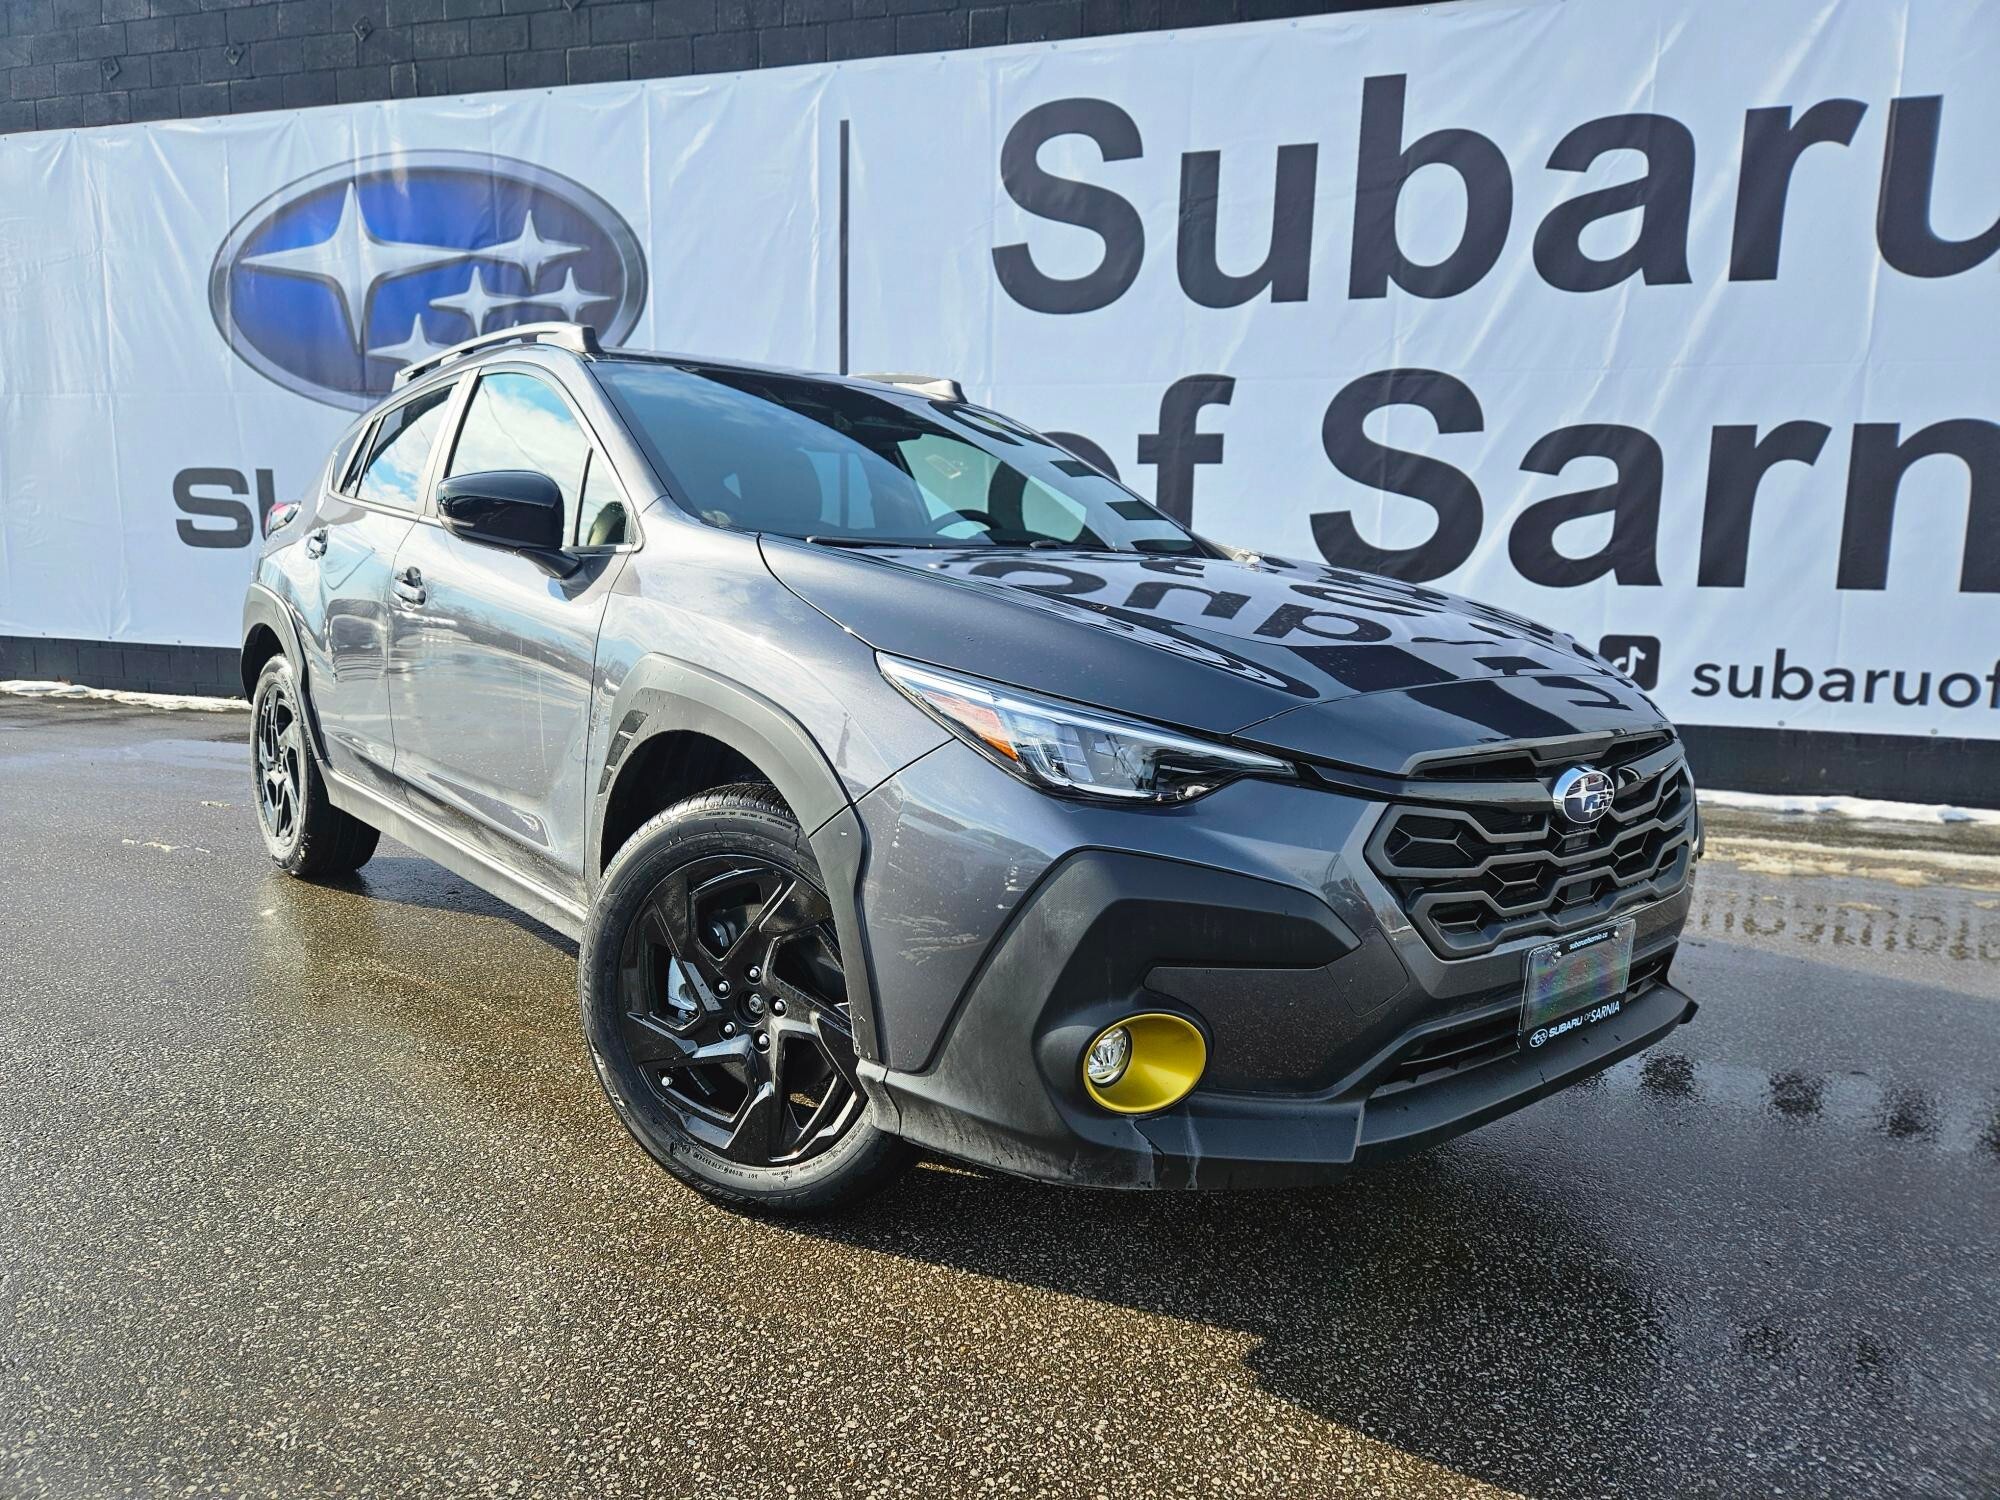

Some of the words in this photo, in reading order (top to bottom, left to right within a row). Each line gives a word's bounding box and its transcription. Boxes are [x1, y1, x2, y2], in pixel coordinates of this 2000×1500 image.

[992, 73, 2000, 314] Subaru
[1309, 367, 2000, 592] Sarn
[1548, 1016, 1583, 1038] SUBARU
[1589, 1000, 1620, 1022] SARNIA
